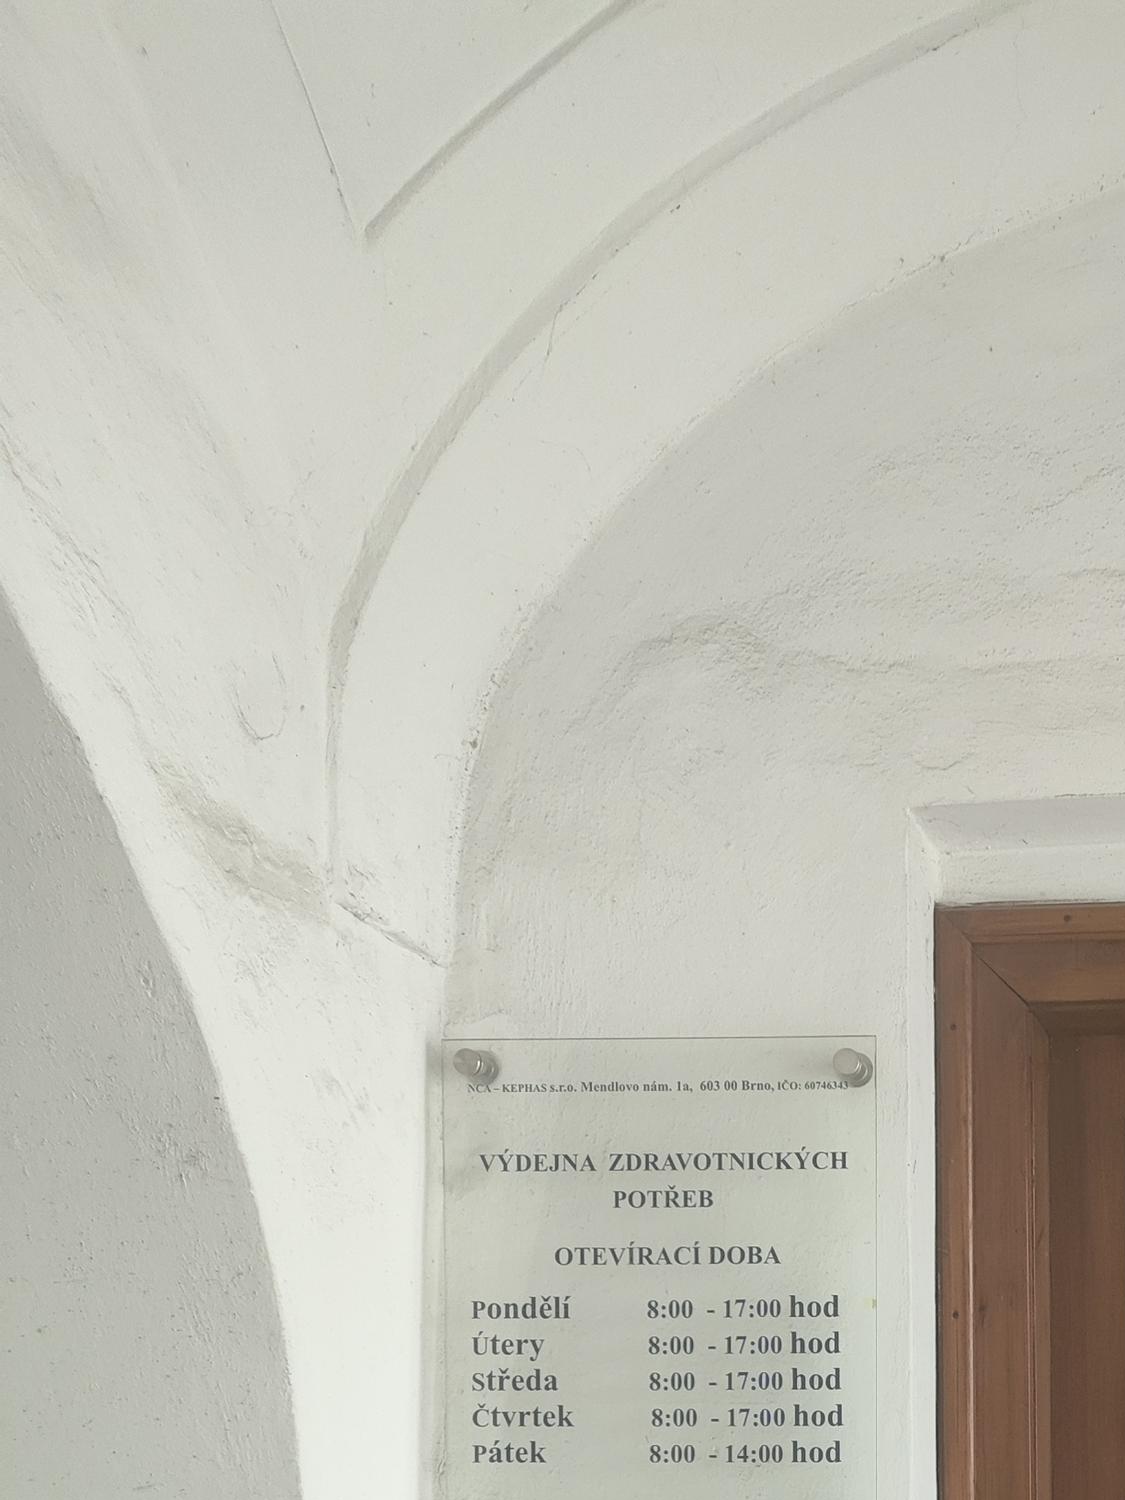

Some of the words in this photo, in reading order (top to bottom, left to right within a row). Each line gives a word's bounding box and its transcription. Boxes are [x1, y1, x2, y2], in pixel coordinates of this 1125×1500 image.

[502, 1083, 548, 1093] KEPHAS
[549, 1084, 578, 1093] s.r.o.
[580, 1082, 640, 1093] Mendlovo
[642, 1081, 673, 1092] nám.
[699, 1081, 721, 1092] 603
[723, 1080, 738, 1092] 00
[741, 1080, 775, 1092] Brno,
[777, 1078, 802, 1092] IČO:
[479, 1149, 597, 1173] VÝDEJNA
[608, 1147, 849, 1172] ZDRAVOTNICKÝCH
[613, 1185, 714, 1209] POTŘEB
[554, 1241, 701, 1266] OTEVÍRACÍ
[708, 1246, 782, 1265] DOBA
[471, 1296, 572, 1320] Pondělí
[647, 1300, 694, 1319] 8:00
[723, 1299, 782, 1319] 17:00
[788, 1295, 840, 1318] hod
[471, 1332, 545, 1362] Útery
[648, 1336, 695, 1355] 8:00
[725, 1336, 783, 1355] 17:00
[789, 1331, 841, 1355] hod
[471, 1368, 559, 1392] Středa
[649, 1373, 695, 1392] 8:00
[725, 1372, 783, 1391] 17:00
[791, 1368, 842, 1391] hod
[472, 1404, 575, 1428] Čtvrtek
[651, 1409, 698, 1428] 8:00
[727, 1408, 786, 1427] 17:00
[793, 1404, 844, 1427] hod
[473, 1440, 547, 1464] Pátek
[649, 1445, 696, 1464] 8:00
[725, 1445, 784, 1464] 14:00
[791, 1441, 842, 1464] hod
